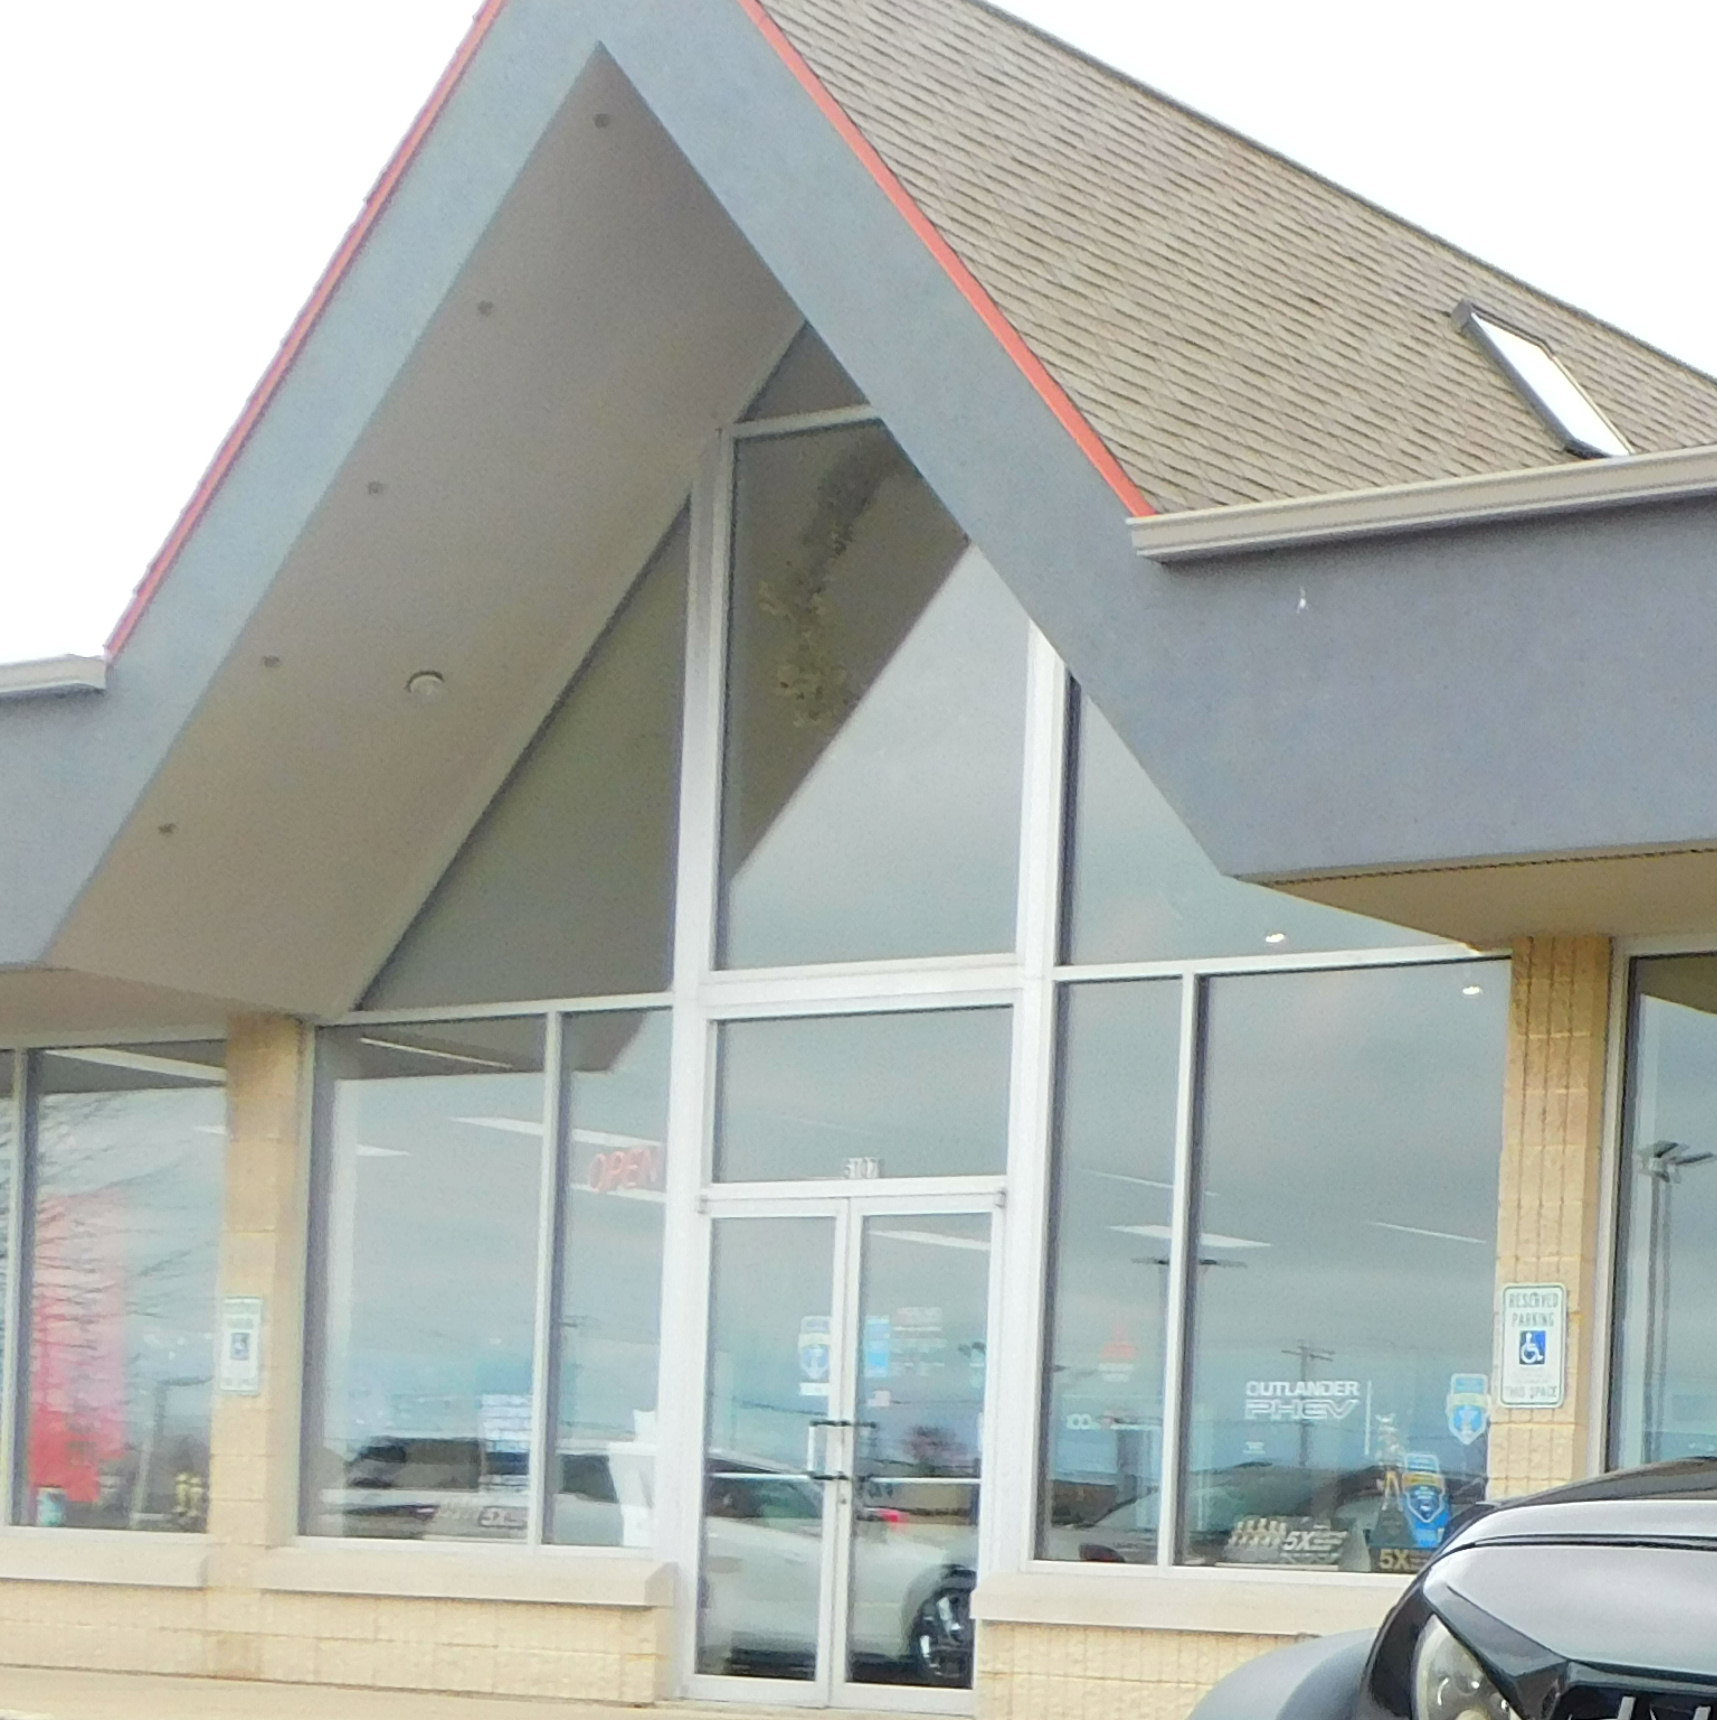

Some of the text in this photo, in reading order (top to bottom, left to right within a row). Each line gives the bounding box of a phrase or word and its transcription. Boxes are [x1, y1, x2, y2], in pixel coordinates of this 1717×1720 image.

[588, 1148, 659, 1195] OPEN
[1508, 1292, 1559, 1308] RESERVED
[1511, 1311, 1554, 1327] PARKING
[1245, 1380, 1361, 1397] OUTLANDER
[1244, 1400, 1361, 1420] PHEV
[1282, 1531, 1316, 1551] 5X
[1380, 1548, 1412, 1571] 5X
